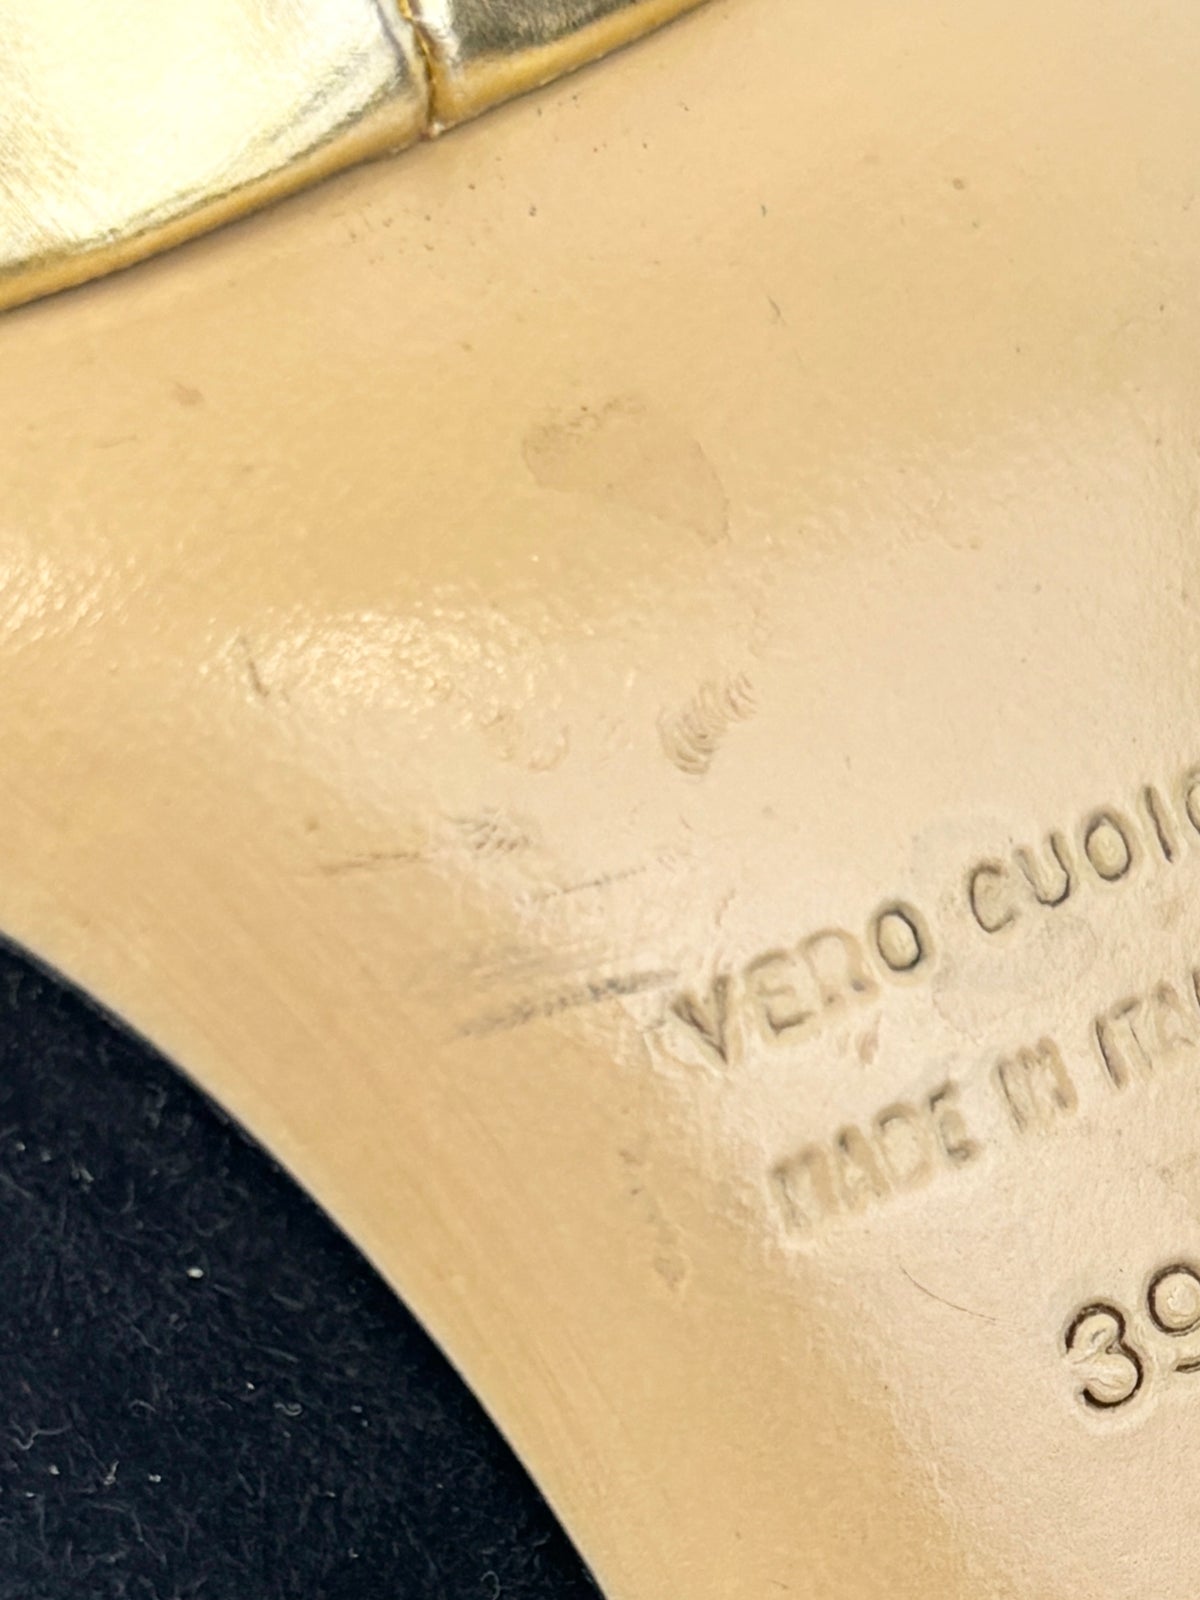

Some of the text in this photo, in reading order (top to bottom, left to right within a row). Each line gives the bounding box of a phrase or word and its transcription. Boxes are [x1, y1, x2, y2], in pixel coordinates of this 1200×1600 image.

[671, 901, 924, 1064] VERO
[769, 1079, 979, 1233] MADE
[992, 1036, 1078, 1134] IN
